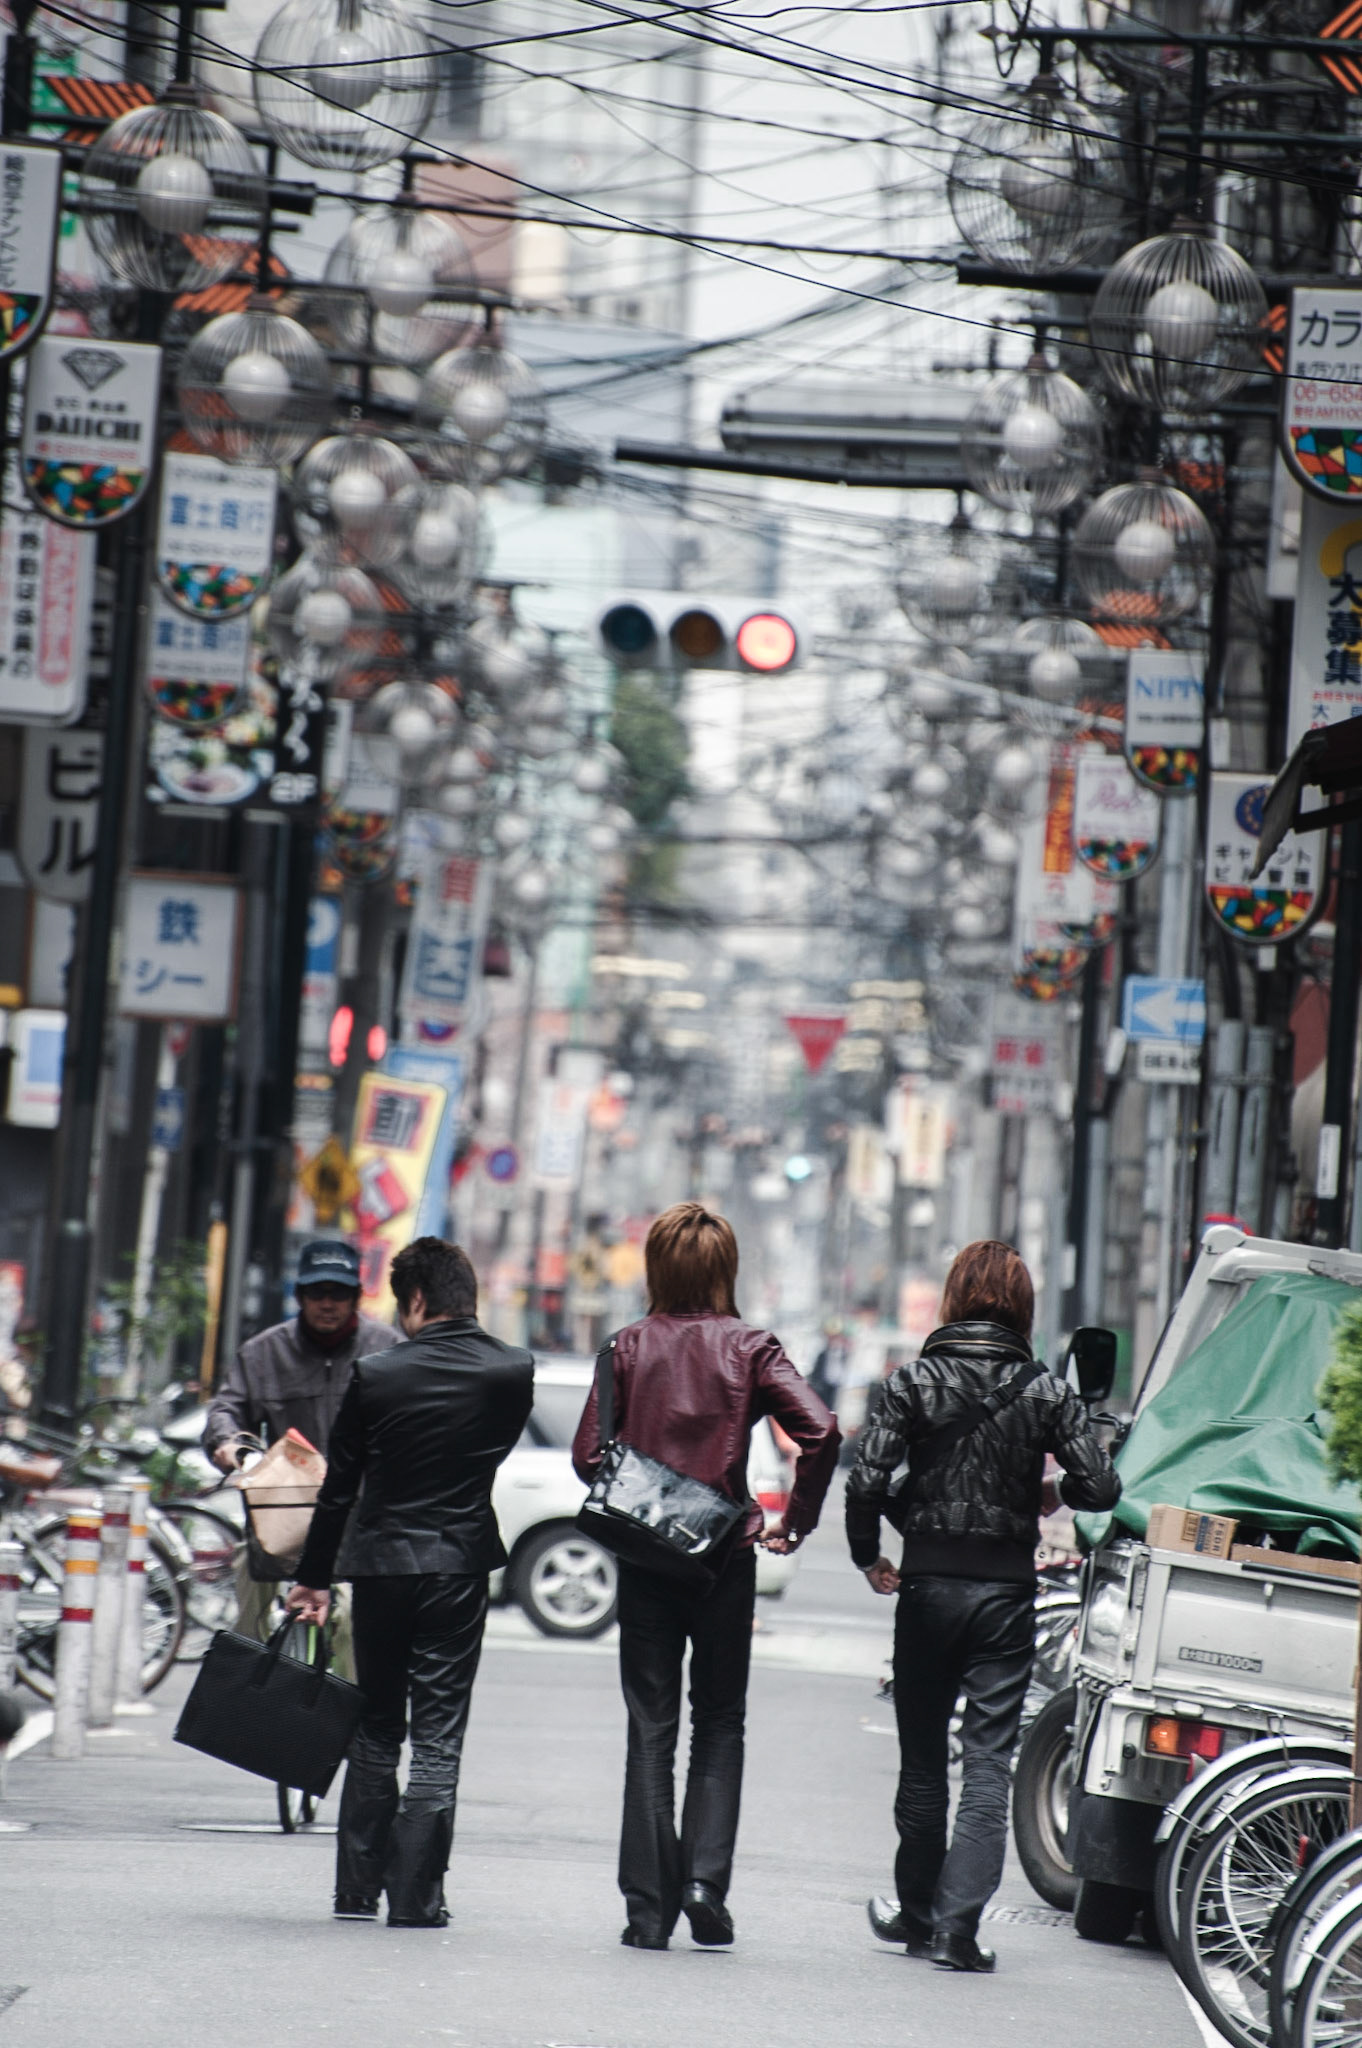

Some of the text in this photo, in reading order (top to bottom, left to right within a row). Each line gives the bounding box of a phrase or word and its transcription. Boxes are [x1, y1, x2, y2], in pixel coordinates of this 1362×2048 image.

[36, 412, 141, 440] DAIICHI
[1324, 573, 1362, 684] 大募集
